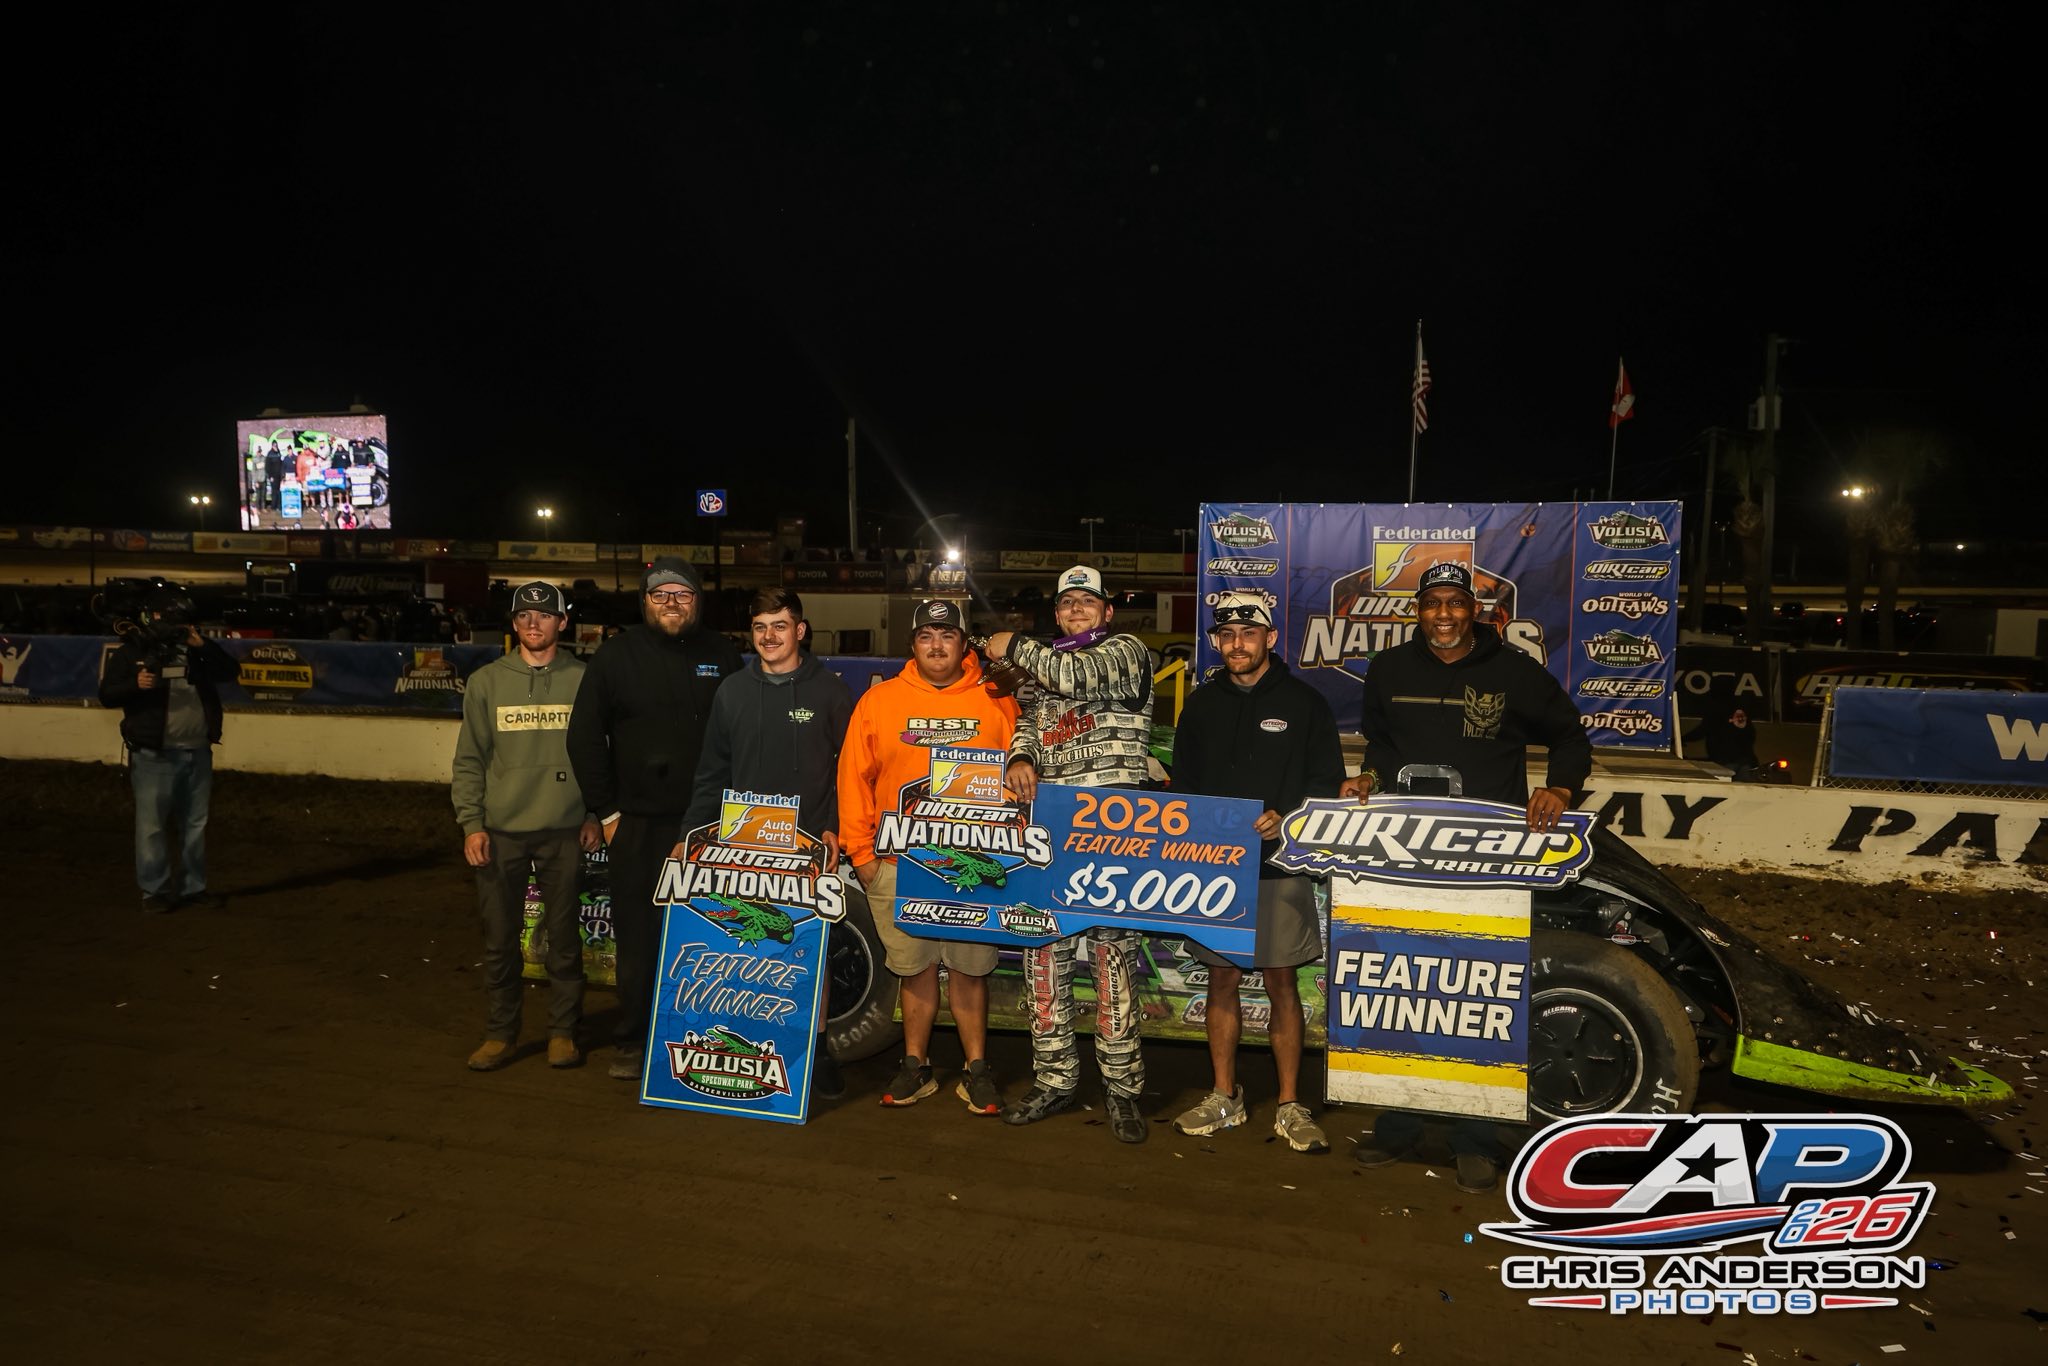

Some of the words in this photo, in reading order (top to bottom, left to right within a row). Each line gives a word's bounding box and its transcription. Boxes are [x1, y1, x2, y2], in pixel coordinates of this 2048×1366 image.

[1213, 526, 1274, 540] VOLUSIA
[1373, 526, 1476, 540] Federated
[1592, 526, 1665, 540] VOLUSIA
[797, 570, 828, 579] TOYOTA
[854, 571, 884, 579] TOYOTA
[1212, 560, 1274, 574] DIRTcar
[1592, 563, 1664, 577] DIRTcar
[1582, 596, 1669, 619] OUTLAWS
[1587, 643, 1660, 659] VOLUSIA
[266, 670, 309, 682] MODELS
[395, 677, 465, 694] NATIONALS
[1586, 679, 1659, 695] DIRTcar
[504, 711, 570, 725] CARHARTT
[908, 718, 979, 731] BEST
[1580, 713, 1662, 736] OUTLAWS
[1042, 713, 1097, 747] BREAKER
[931, 748, 1005, 763] Federated
[1067, 743, 1104, 763] CHIPS
[970, 774, 999, 786] Auto
[724, 789, 800, 807] Federated
[965, 784, 999, 797] Parts
[914, 800, 1019, 823] DIRTcar
[1072, 792, 1190, 836] 2026
[763, 819, 792, 831] Auto
[756, 827, 792, 843] Parts
[877, 815, 1051, 864] NATIONALS
[1297, 809, 1575, 862] DIRTcar
[1063, 832, 1156, 858] FEATURE
[1161, 841, 1246, 866] WINNER
[699, 846, 812, 871] DIRTcar
[1433, 859, 1559, 877] RACING
[657, 861, 843, 917] NATIONALS
[1063, 862, 1237, 918] $5,000
[906, 902, 984, 920] DIRTcar
[1000, 913, 1057, 931] VOLUSIA
[669, 942, 809, 991] FEATURE
[1334, 950, 1526, 999] FEATURE
[674, 978, 798, 1025] WINNER
[1340, 991, 1514, 1041] WINNER
[1542, 1005, 1578, 1018] ALLGAIER
[672, 1047, 785, 1088] VOLUSIA
[689, 1081, 747, 1098] BARBERVILLE
[701, 1074, 735, 1088] SPEEDWAY
[737, 1079, 754, 1090] PARK
